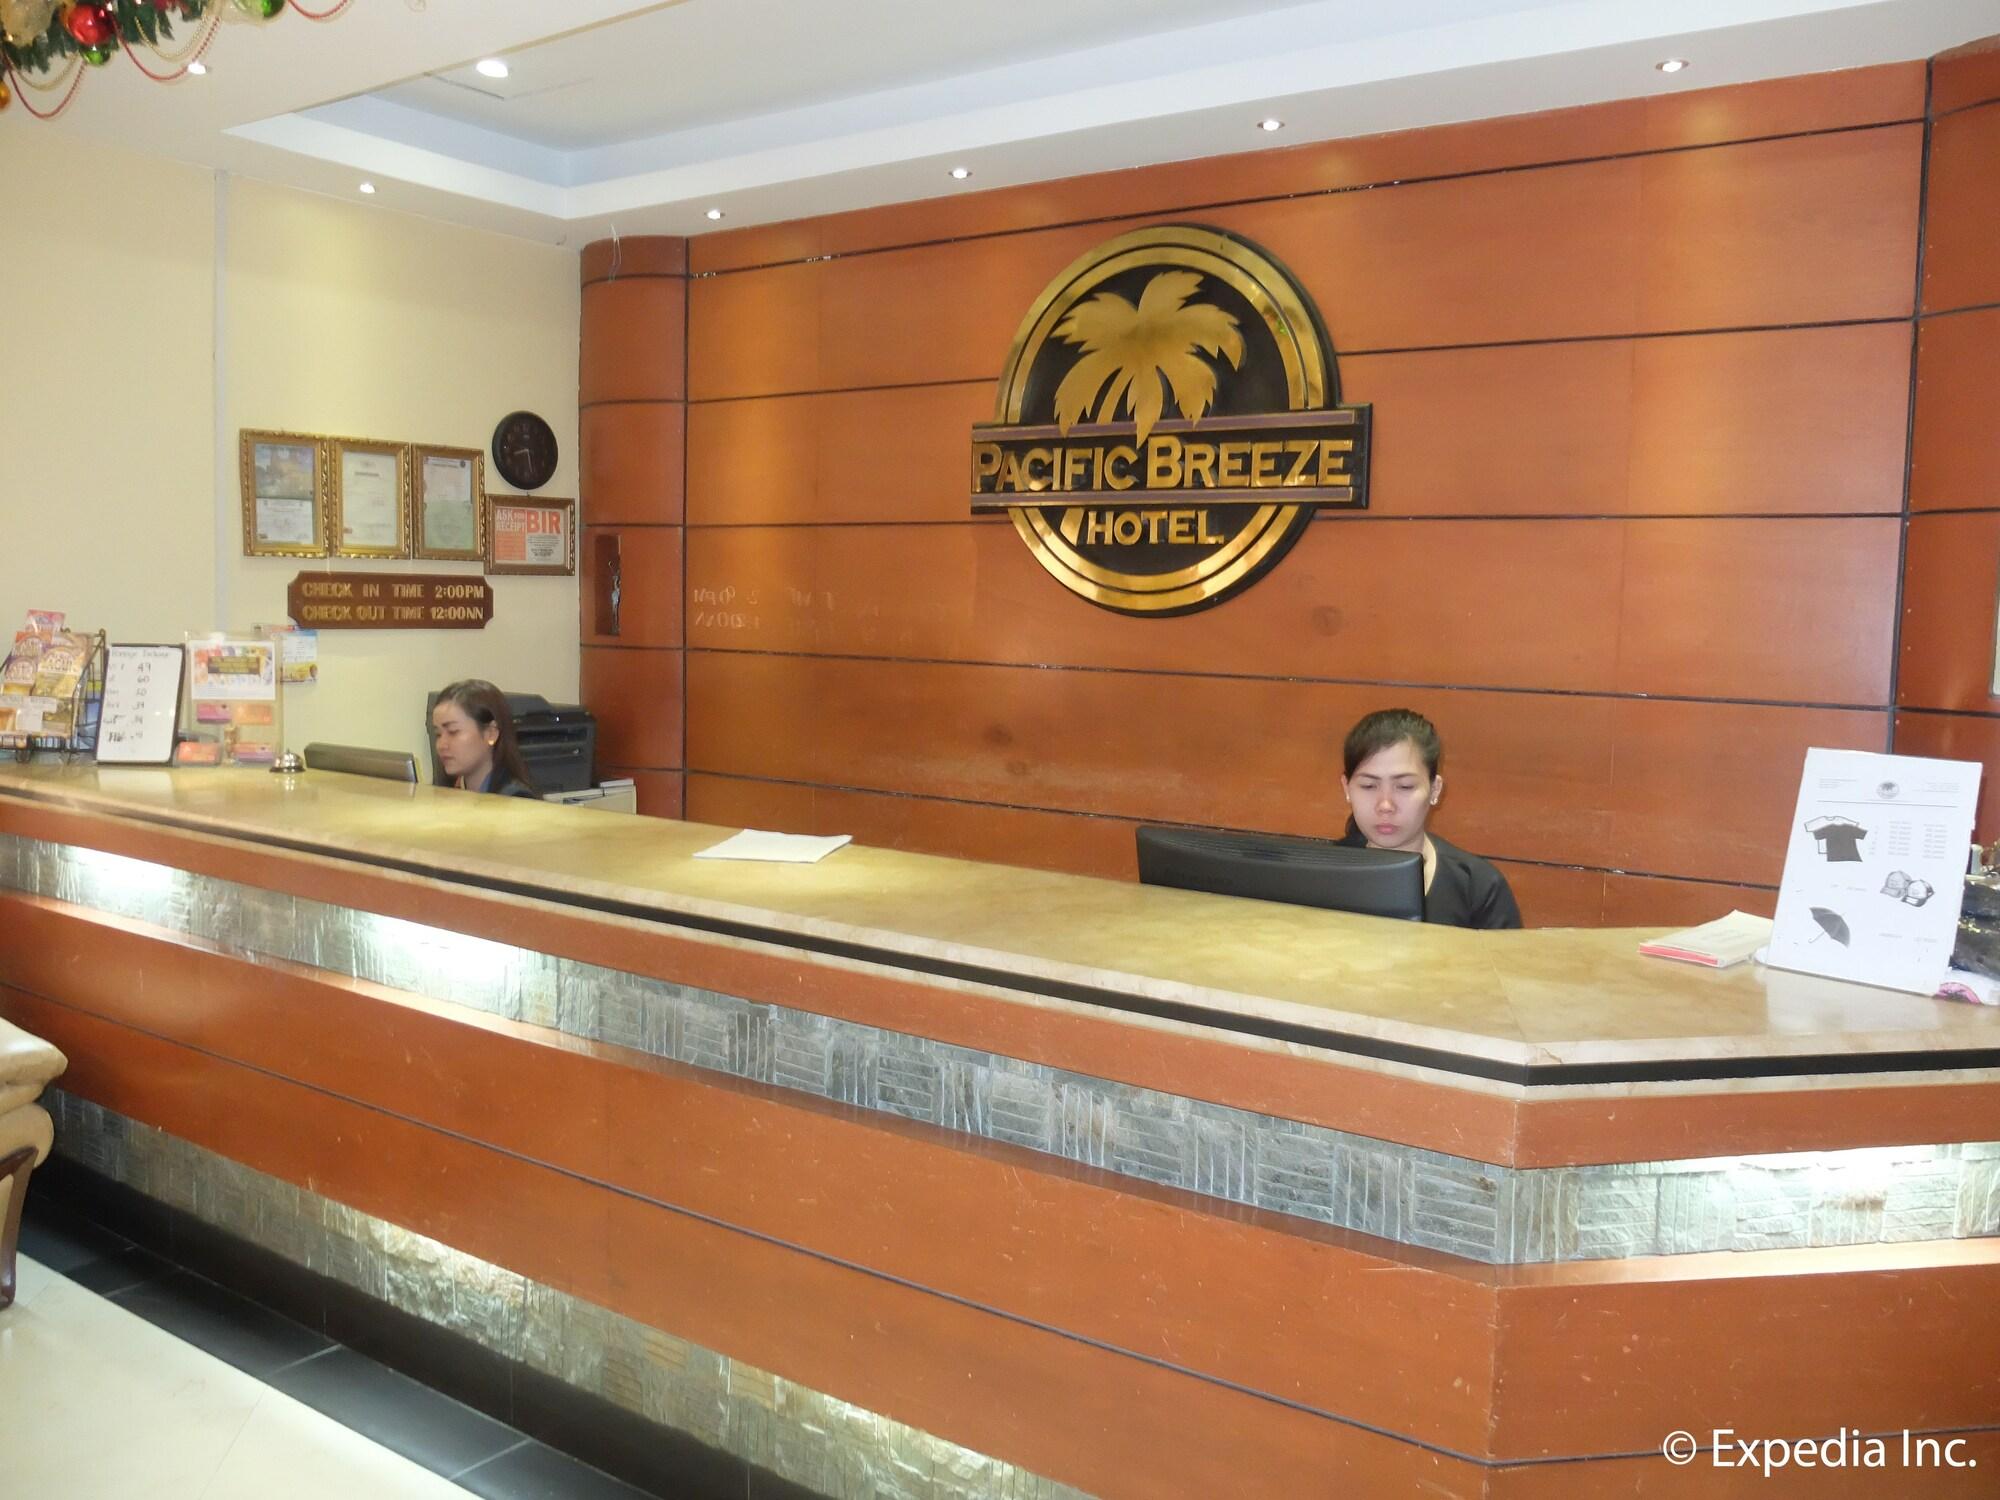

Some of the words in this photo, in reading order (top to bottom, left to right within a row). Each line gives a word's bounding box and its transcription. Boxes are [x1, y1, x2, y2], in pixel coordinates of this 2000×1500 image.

[971, 442, 1139, 493] PACIFIC
[1146, 435, 1353, 489] BREEZE
[496, 507, 512, 520] ASK
[527, 510, 561, 534] BIR
[1087, 510, 1225, 546] HOTEL
[302, 582, 353, 598] CHECK
[362, 583, 380, 598] IN
[391, 584, 424, 598] TIME
[435, 585, 485, 599] 2:00PM
[302, 605, 352, 621] CHECK
[356, 605, 386, 620] OUT
[392, 605, 424, 620] TIME
[430, 606, 484, 620] 12:00NN
